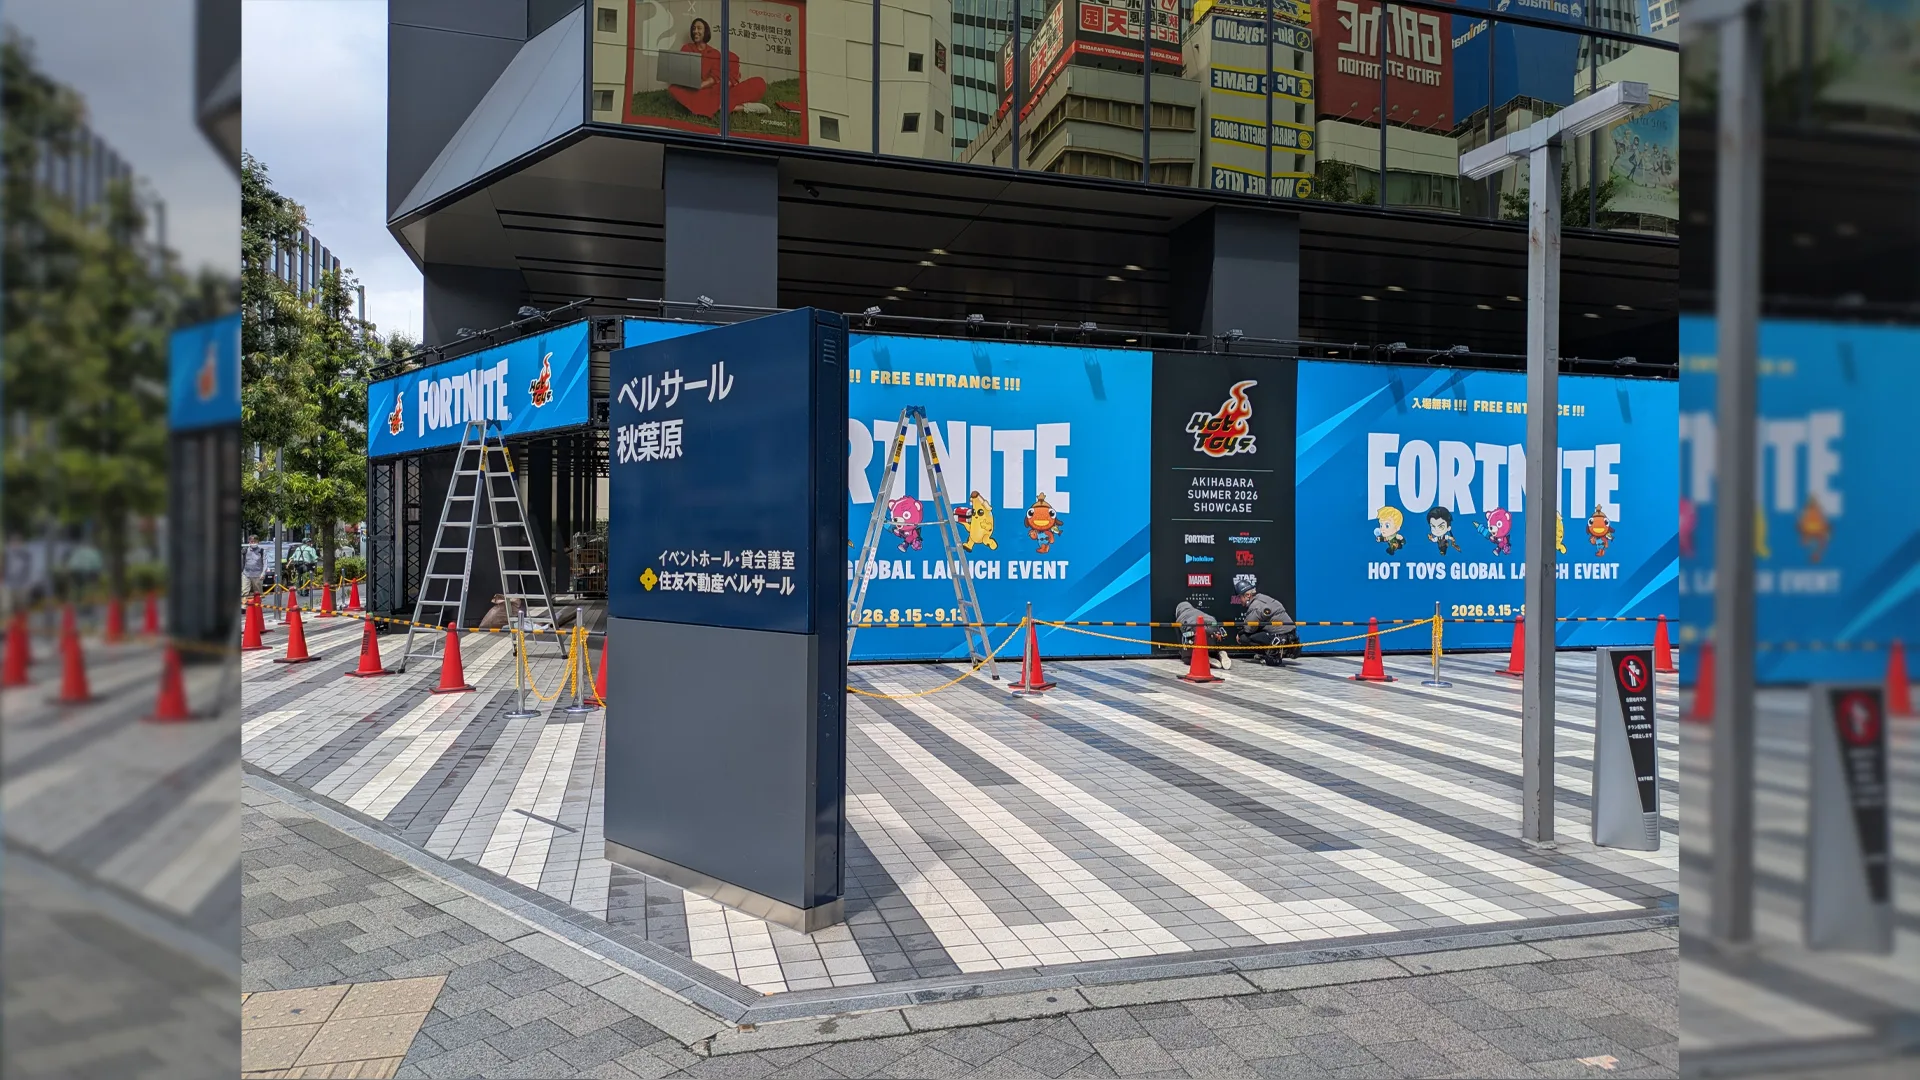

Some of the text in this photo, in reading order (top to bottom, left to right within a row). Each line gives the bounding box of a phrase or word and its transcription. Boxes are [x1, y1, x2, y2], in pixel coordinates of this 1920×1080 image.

[617, 361, 735, 414] ベルサール
[870, 370, 911, 386] FREE
[915, 372, 1001, 390] ENTRANCE
[1004, 377, 1021, 392] !!!
[418, 358, 508, 439] FORTNITE
[1411, 397, 1585, 417] 入場無料 !!! FREE ENTCE !!!
[616, 417, 684, 465] 秋葉原
[1191, 476, 1255, 488] AKIHABARA
[1187, 489, 1259, 502] SUMMER 2026
[1193, 501, 1253, 513] SHOWCASE
[1184, 534, 1215, 545] FORTNITE
[658, 549, 796, 570] イベントホール・貸会議室
[1008, 560, 1069, 580] EVENT
[1368, 562, 1400, 580] HOT
[1406, 562, 1446, 580] TOYS
[1450, 562, 1506, 580] GLOBAL
[1574, 562, 1620, 580] EVENT
[658, 571, 796, 596] 住友不動産ベルサール
[1188, 575, 1211, 586] MARVEL
